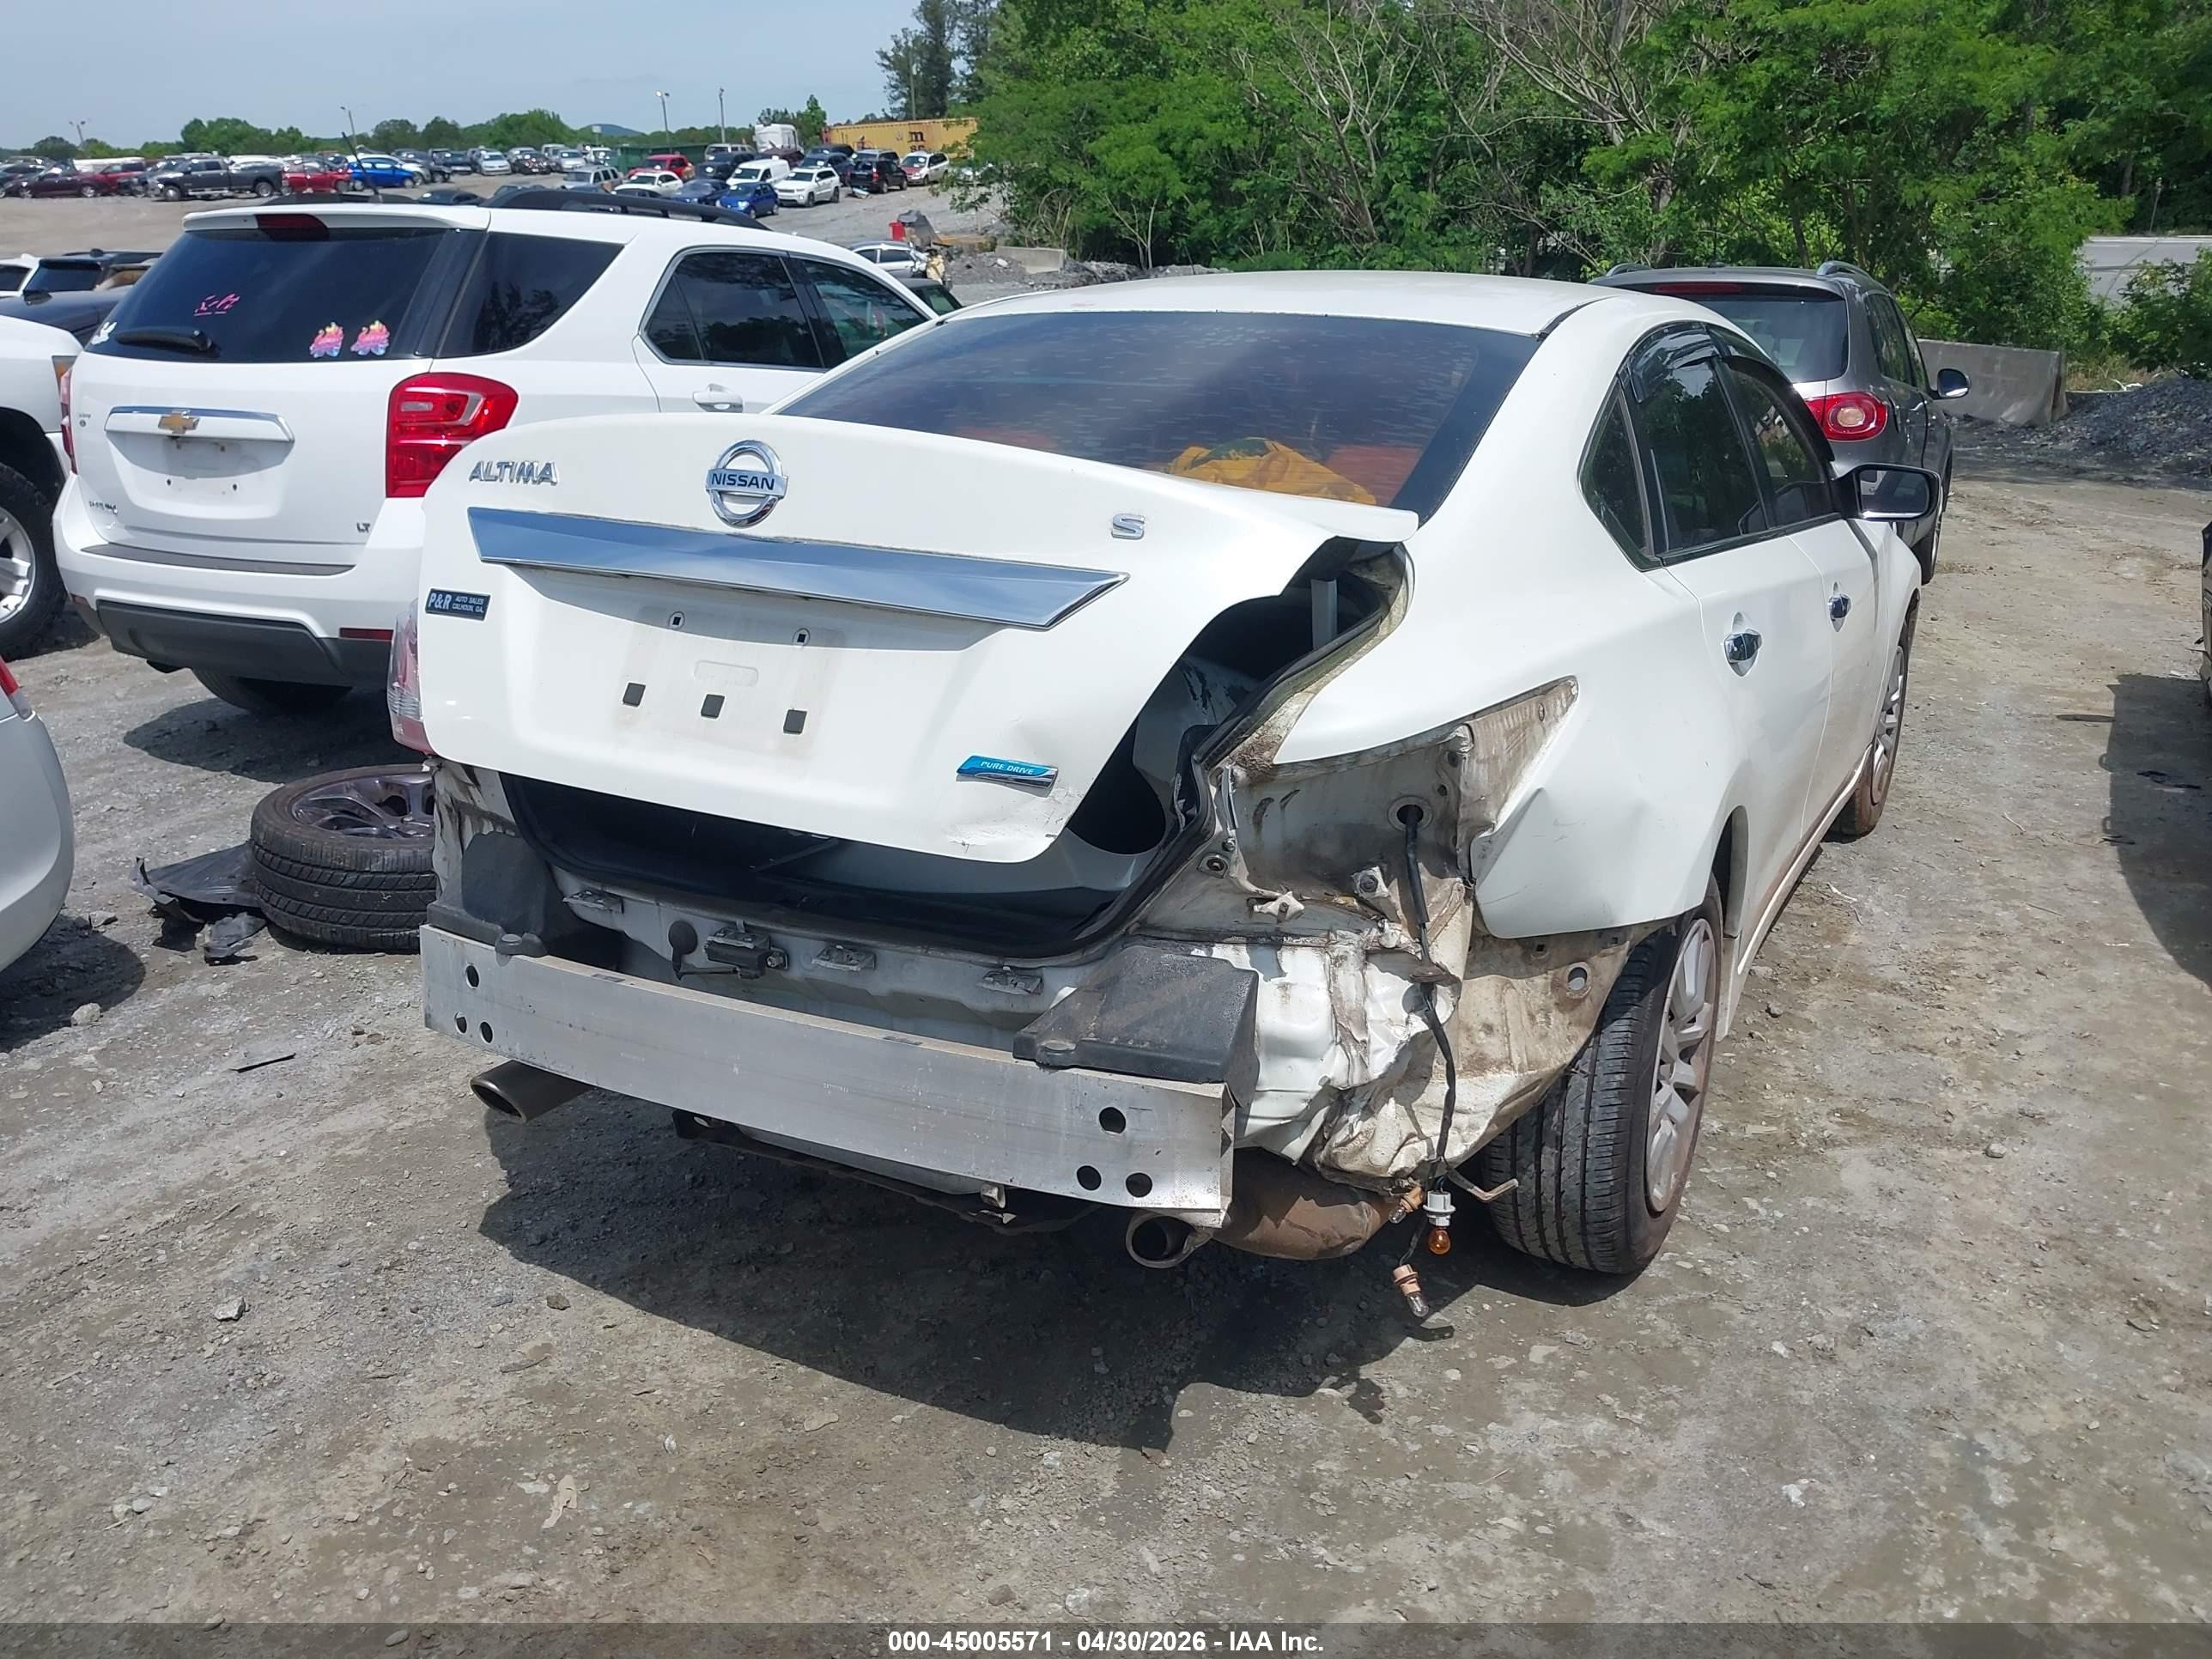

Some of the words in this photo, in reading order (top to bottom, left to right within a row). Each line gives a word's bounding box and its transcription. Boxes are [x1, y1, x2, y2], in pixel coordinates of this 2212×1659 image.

[468, 460, 557, 486] ALTIMA
[711, 473, 775, 490] NISSAN
[356, 522, 370, 532] LT
[1111, 514, 1145, 540] S
[428, 592, 453, 610] P&R
[469, 597, 484, 605] SALES
[981, 761, 1004, 770] PURE
[1006, 765, 1035, 775] DRIVE
